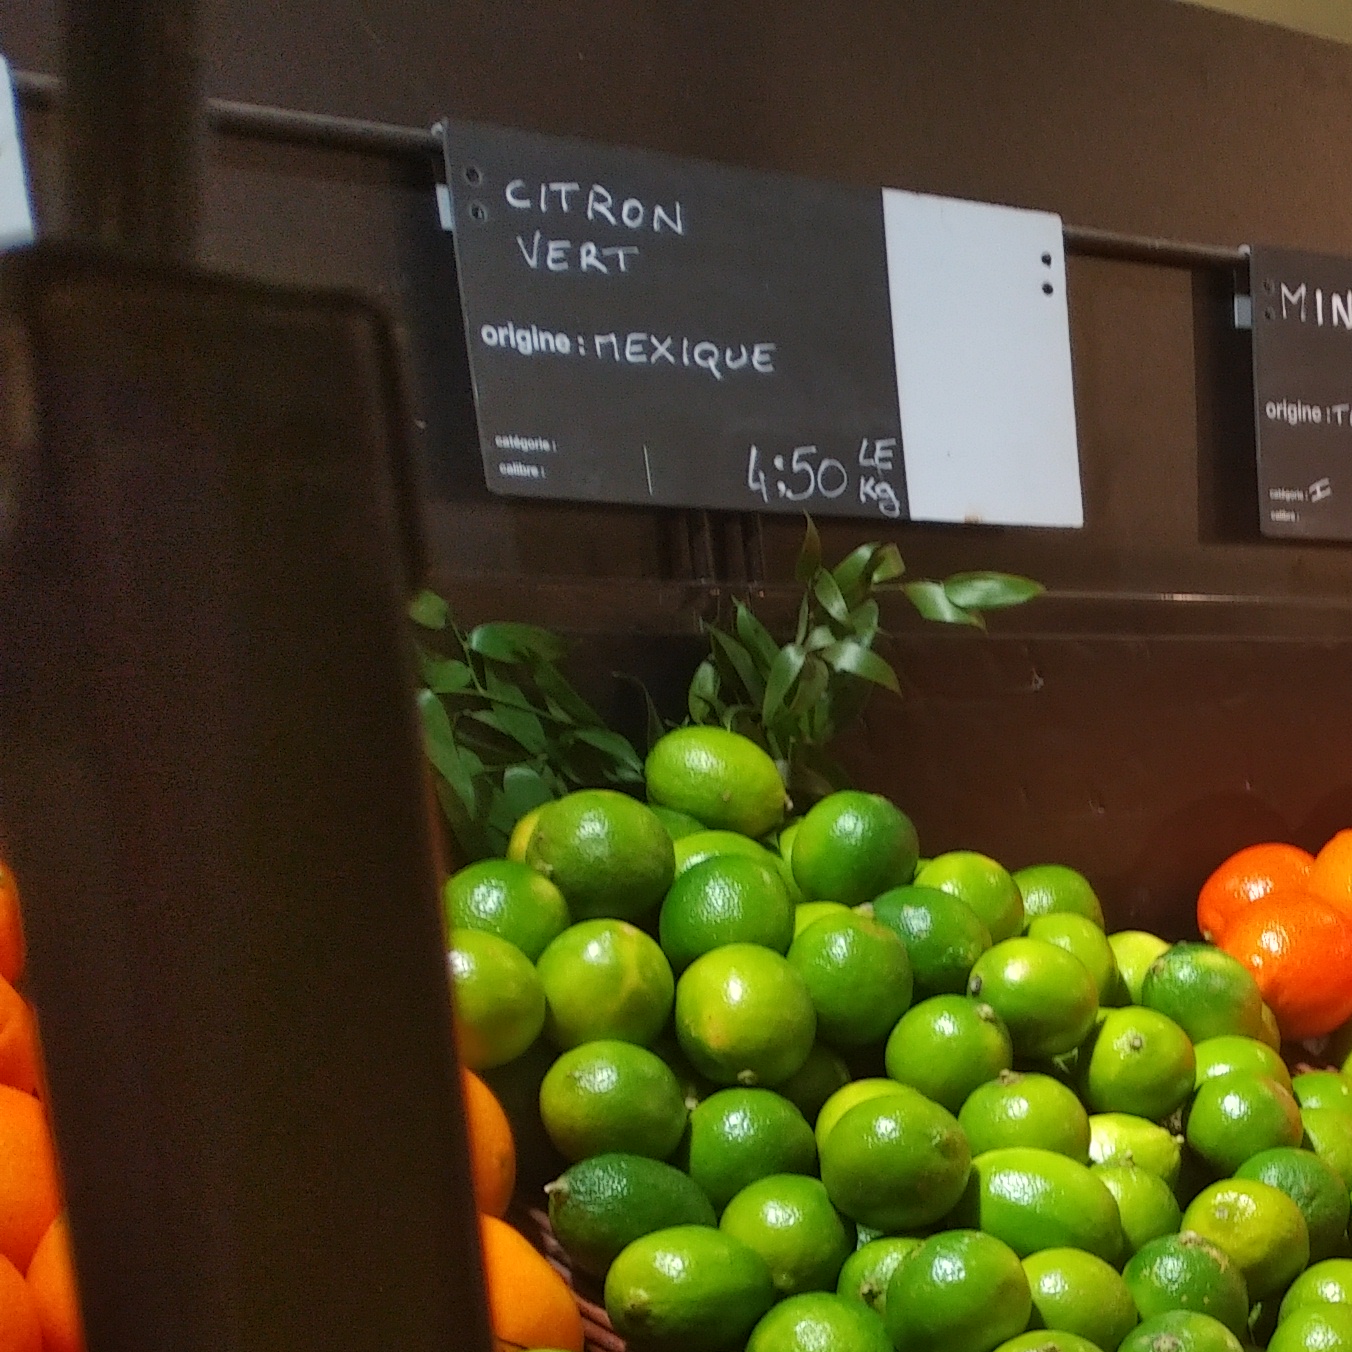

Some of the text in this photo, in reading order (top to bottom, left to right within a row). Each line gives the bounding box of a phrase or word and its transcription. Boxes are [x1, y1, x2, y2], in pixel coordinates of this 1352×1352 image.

[505, 178, 685, 236] CITRON
[516, 229, 640, 274] VERT
[592, 330, 776, 379] MEXIQUE
[858, 437, 897, 471] LE
